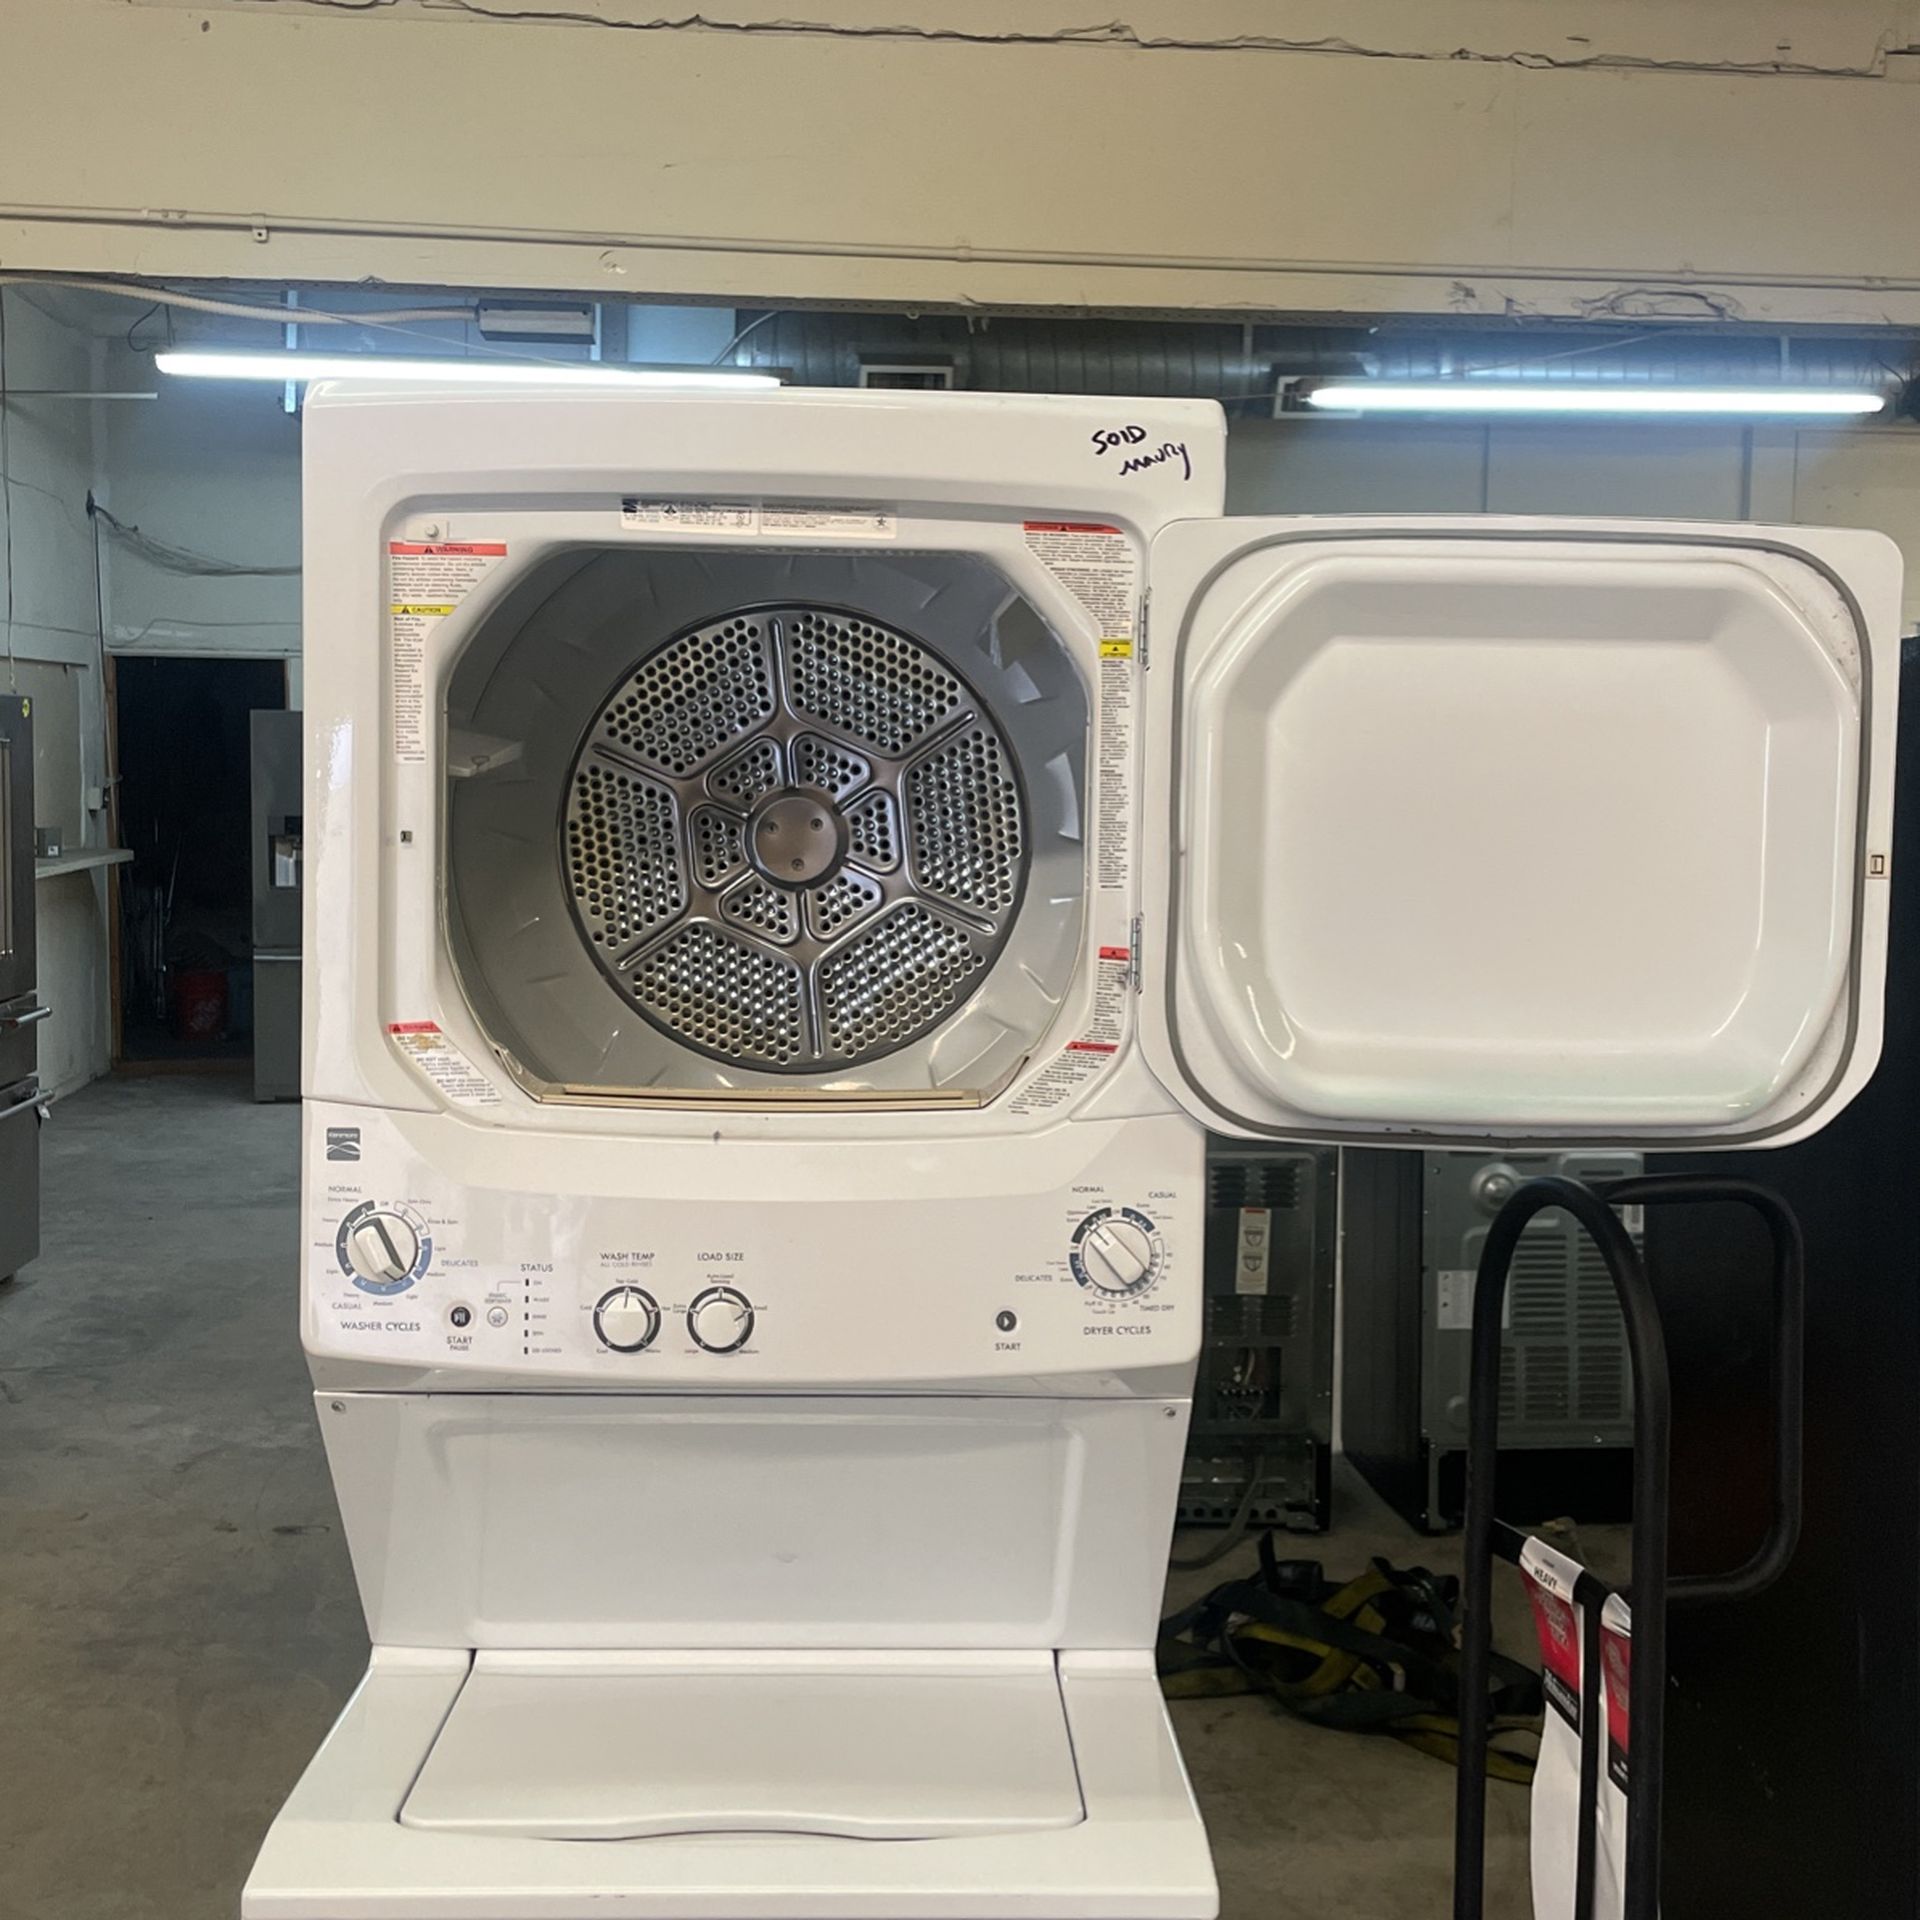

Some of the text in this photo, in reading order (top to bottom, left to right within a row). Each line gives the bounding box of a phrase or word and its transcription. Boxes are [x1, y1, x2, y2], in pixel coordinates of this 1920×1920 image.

[1071, 1185, 1104, 1194] NORMAL
[1148, 1191, 1177, 1199] CASUAL
[600, 1252, 656, 1261] WASH TEMP
[697, 1252, 745, 1261] LOAD SIZE
[441, 1259, 479, 1267] DELICATES
[520, 1263, 554, 1273] STATUS
[1015, 1274, 1053, 1282] DELICATES
[331, 1303, 362, 1311] CASUAL
[340, 1321, 422, 1333] WASHER CYCLES
[1083, 1325, 1152, 1336] DRYER CYCLES
[446, 1335, 473, 1345] START
[995, 1342, 1021, 1351] START
[1533, 1566, 1558, 1589] HEAVY
